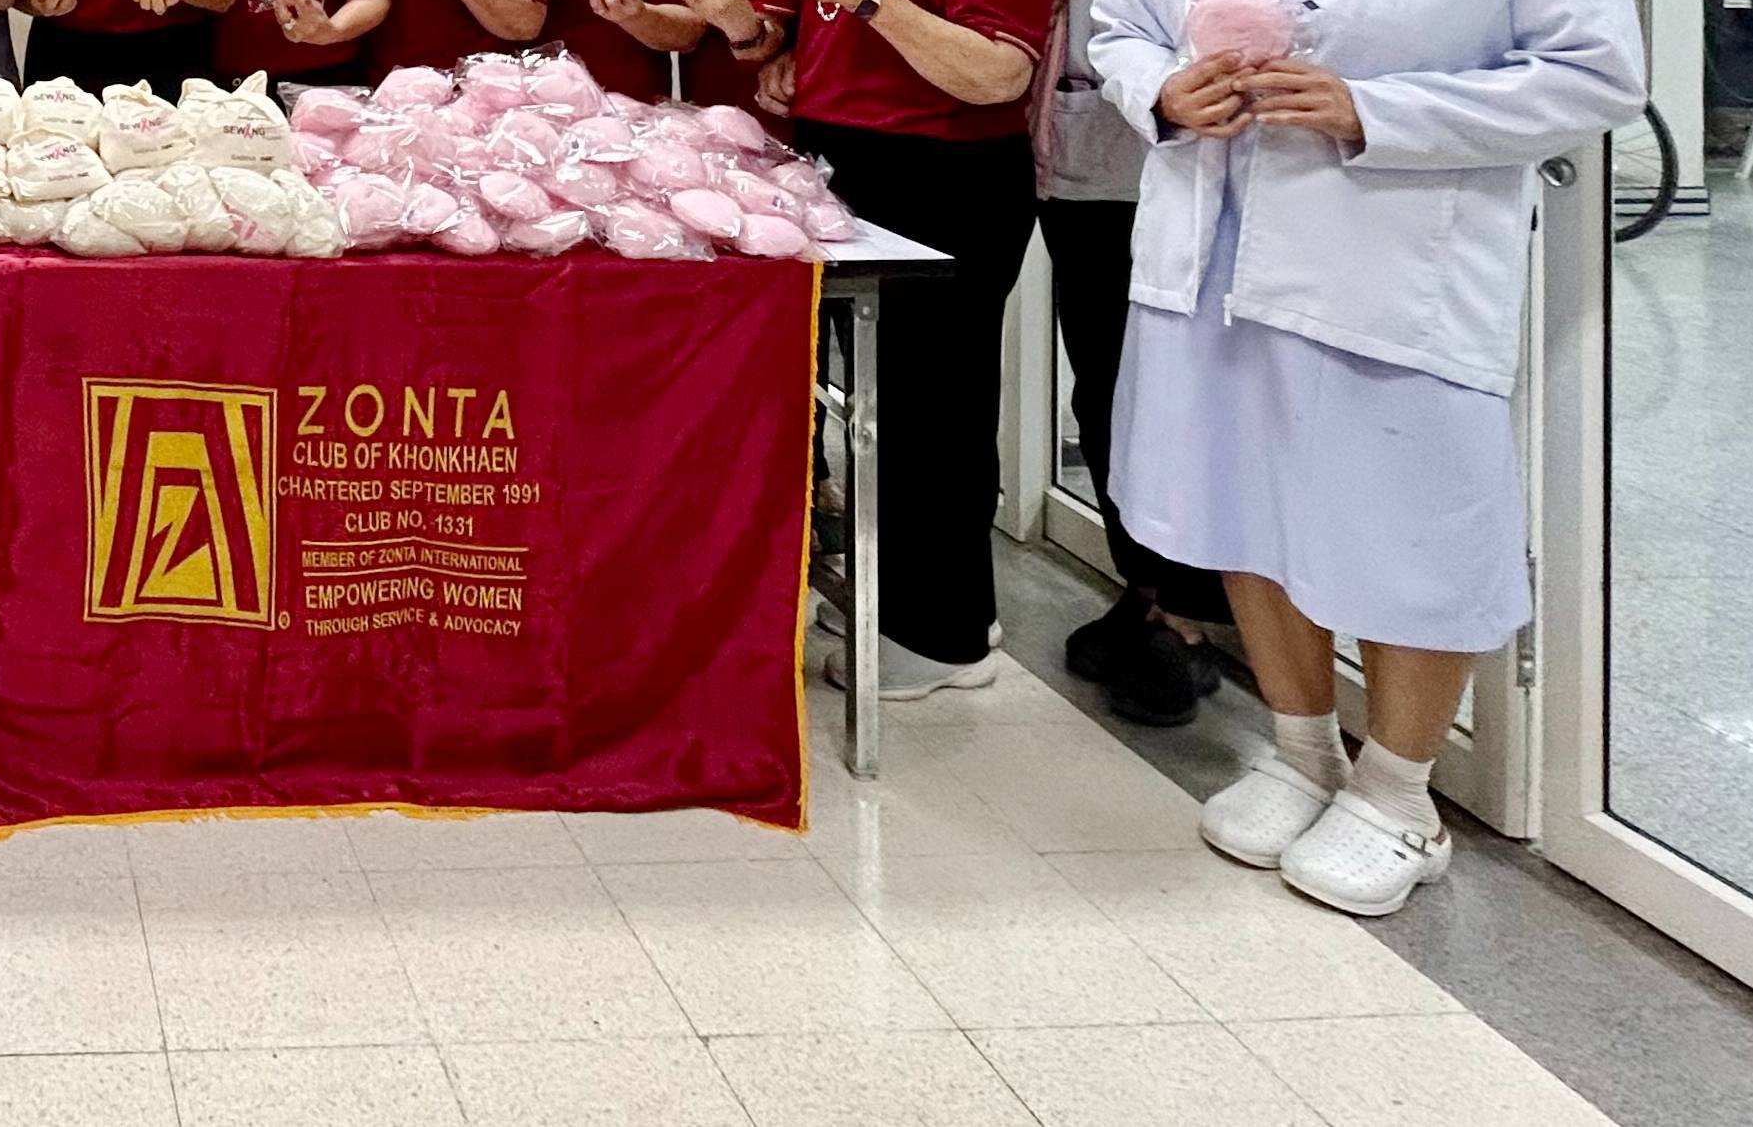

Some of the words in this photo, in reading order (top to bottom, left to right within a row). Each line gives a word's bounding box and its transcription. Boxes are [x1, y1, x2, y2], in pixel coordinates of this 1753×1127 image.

[296, 383, 516, 440] ZONTA
[292, 440, 348, 470] CLUB
[353, 442, 383, 470] OF
[388, 441, 518, 473] KHONKHAEN
[277, 475, 384, 503] CHARTERED
[390, 479, 495, 506] SEPTEMBER
[502, 482, 541, 505] 1991
[345, 511, 391, 534] CLUB
[397, 510, 427, 531] NO.
[434, 514, 474, 537] 1331
[301, 550, 356, 568] MEMBER
[359, 549, 375, 565] OF
[378, 546, 417, 564] ZONTA
[420, 548, 524, 572] INTERNATIONAL
[304, 576, 435, 610] EMPOWERING
[442, 581, 523, 611] WOMEN
[304, 614, 369, 637] THROUGH
[372, 607, 425, 629] SERVICE
[428, 611, 439, 627] &
[444, 614, 522, 637] ADVOCACY
